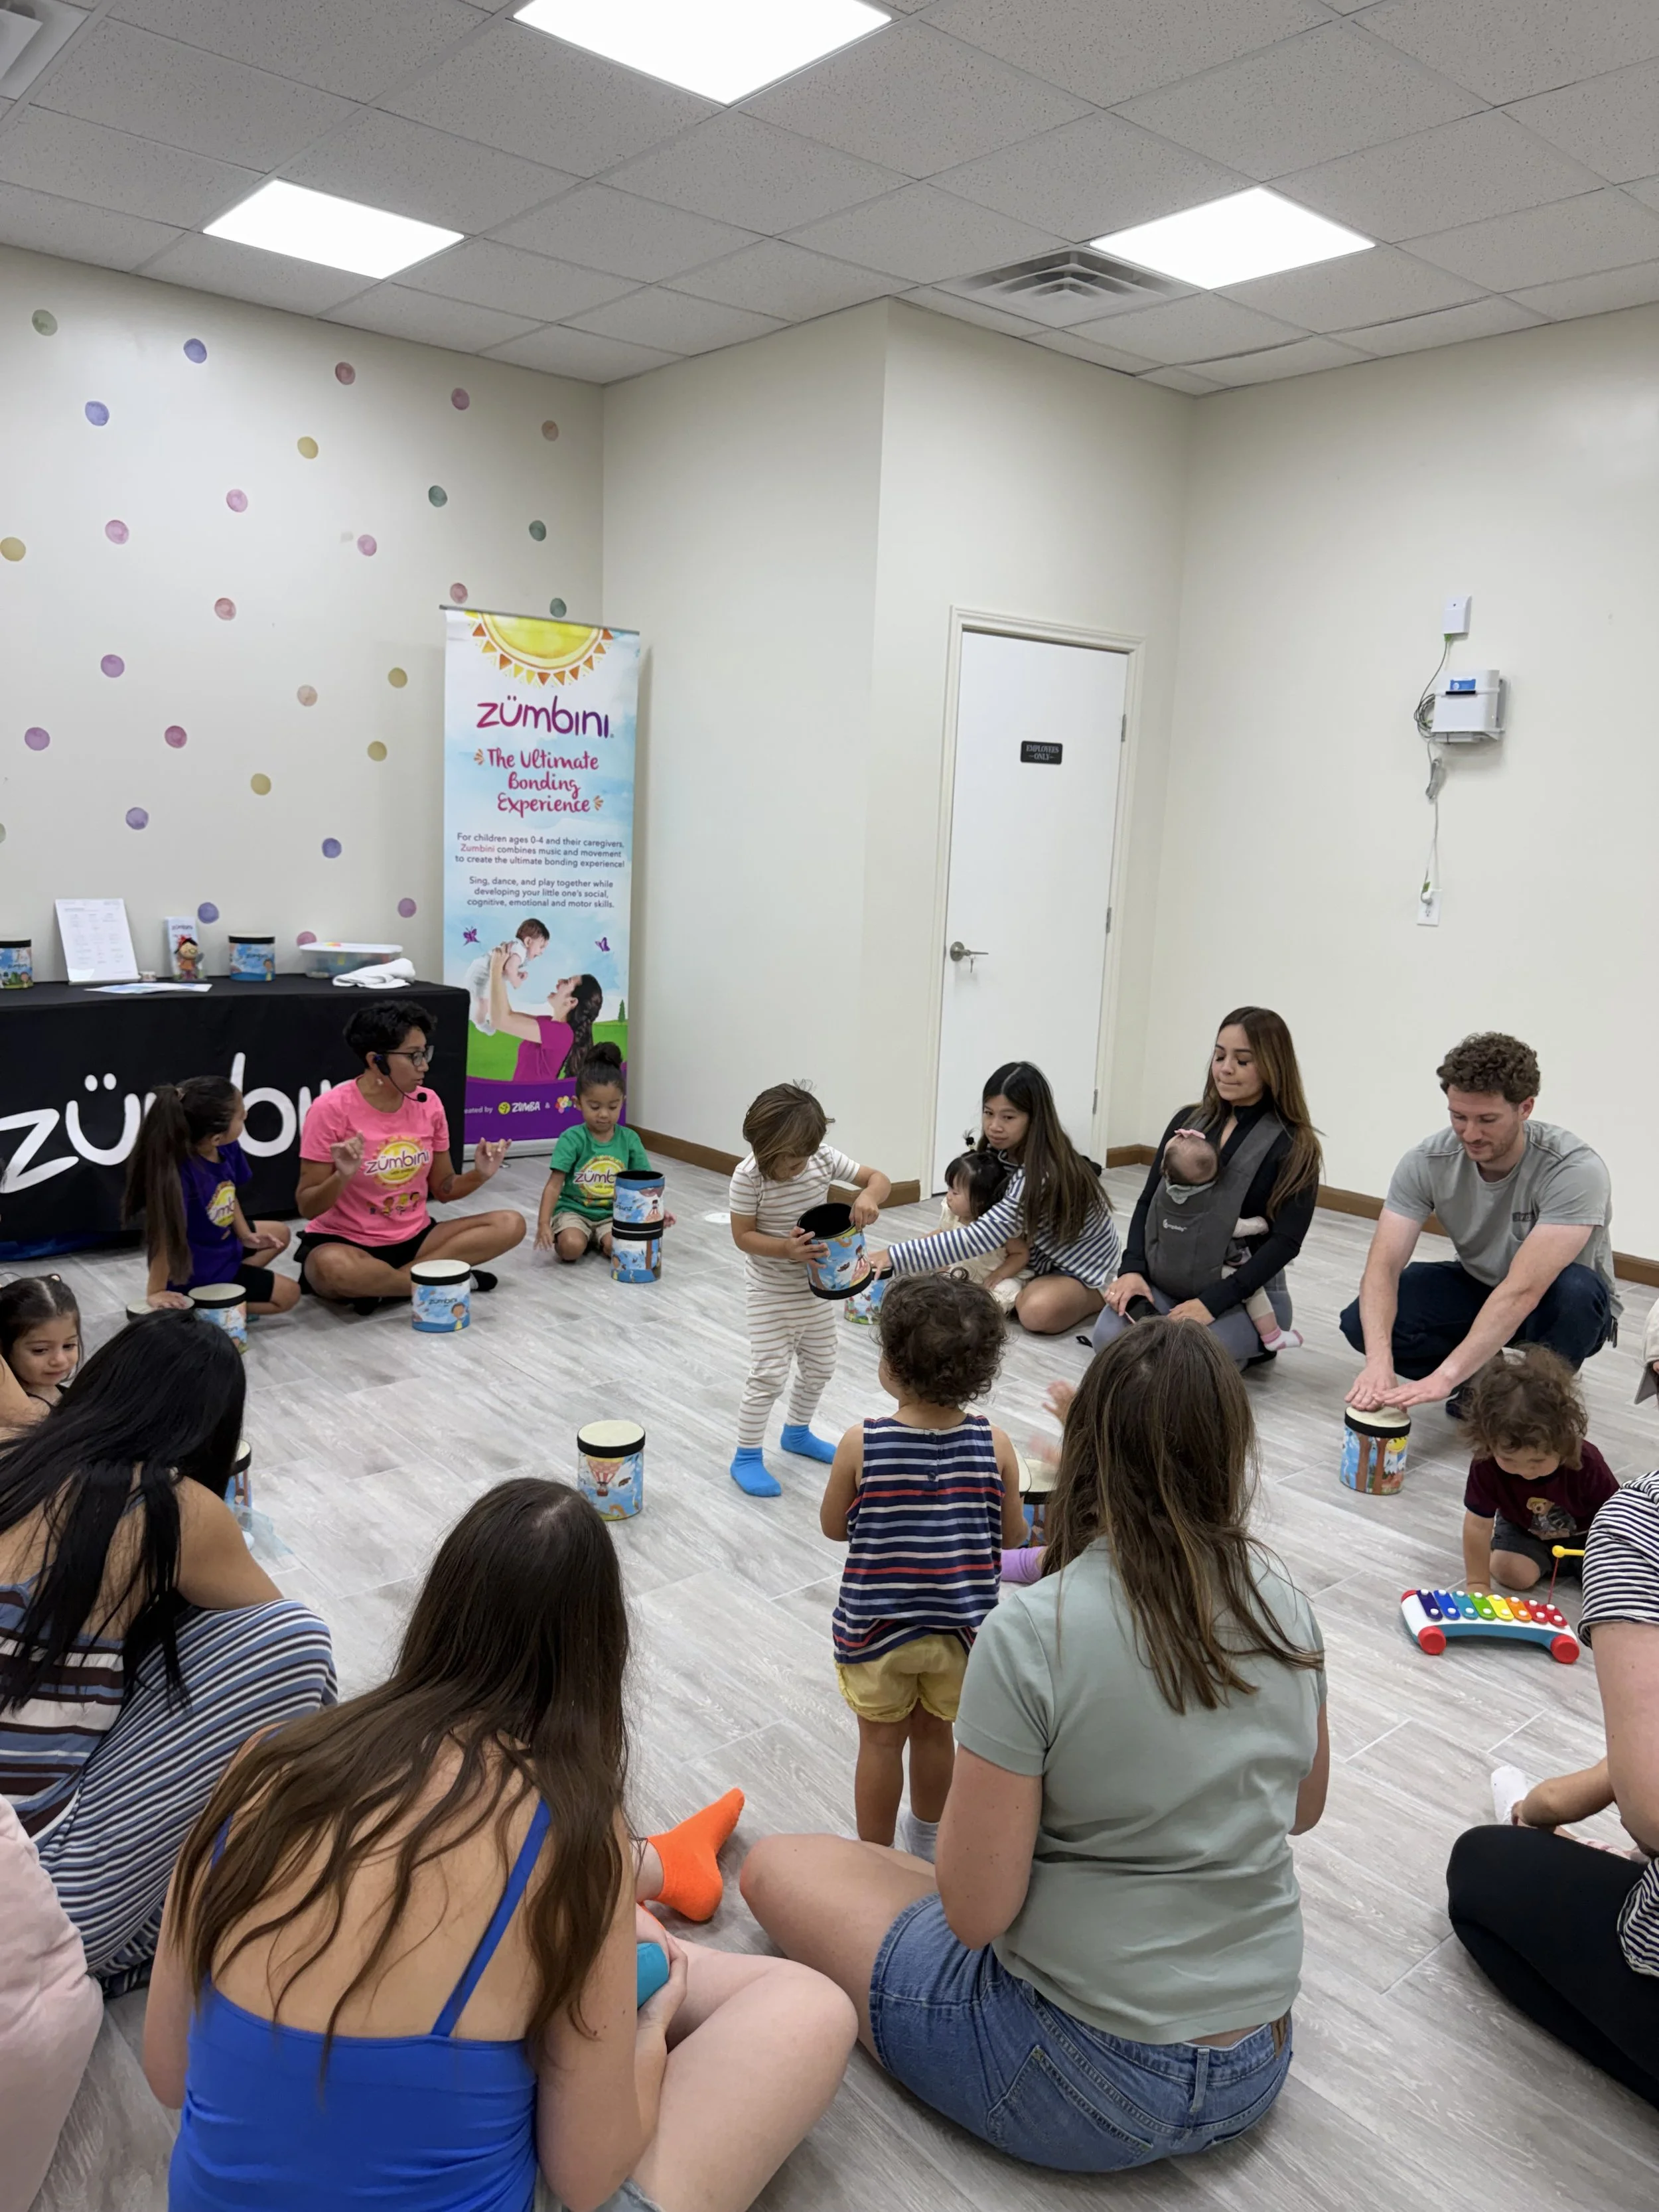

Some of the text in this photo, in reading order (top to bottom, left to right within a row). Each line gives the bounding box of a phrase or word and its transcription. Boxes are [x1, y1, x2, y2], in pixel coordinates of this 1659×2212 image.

[1026, 744, 1059, 753] EMPLOYEES
[487, 747, 599, 770] The Ultimate
[508, 771, 581, 799] Bonding
[498, 792, 591, 818] Experience
[457, 832, 472, 841] For
[473, 834, 507, 843] children
[461, 844, 495, 852] Zumbini
[494, 855, 508, 864] the
[509, 856, 542, 865] ultimate
[544, 857, 578, 868] bonding
[580, 860, 624, 869] experience!
[469, 876, 490, 886] Sing,
[492, 877, 519, 886] dance,
[538, 878, 555, 888] play
[557, 879, 591, 889] together
[474, 888, 520, 898] developing
[584, 890, 609, 899] social,
[467, 898, 507, 908] cognitive,
[594, 900, 614, 909] skills.
[512, 1101, 541, 1113] ZUMBA
[366, 1149, 429, 1174] zümbini
[575, 1169, 618, 1183] zümb
